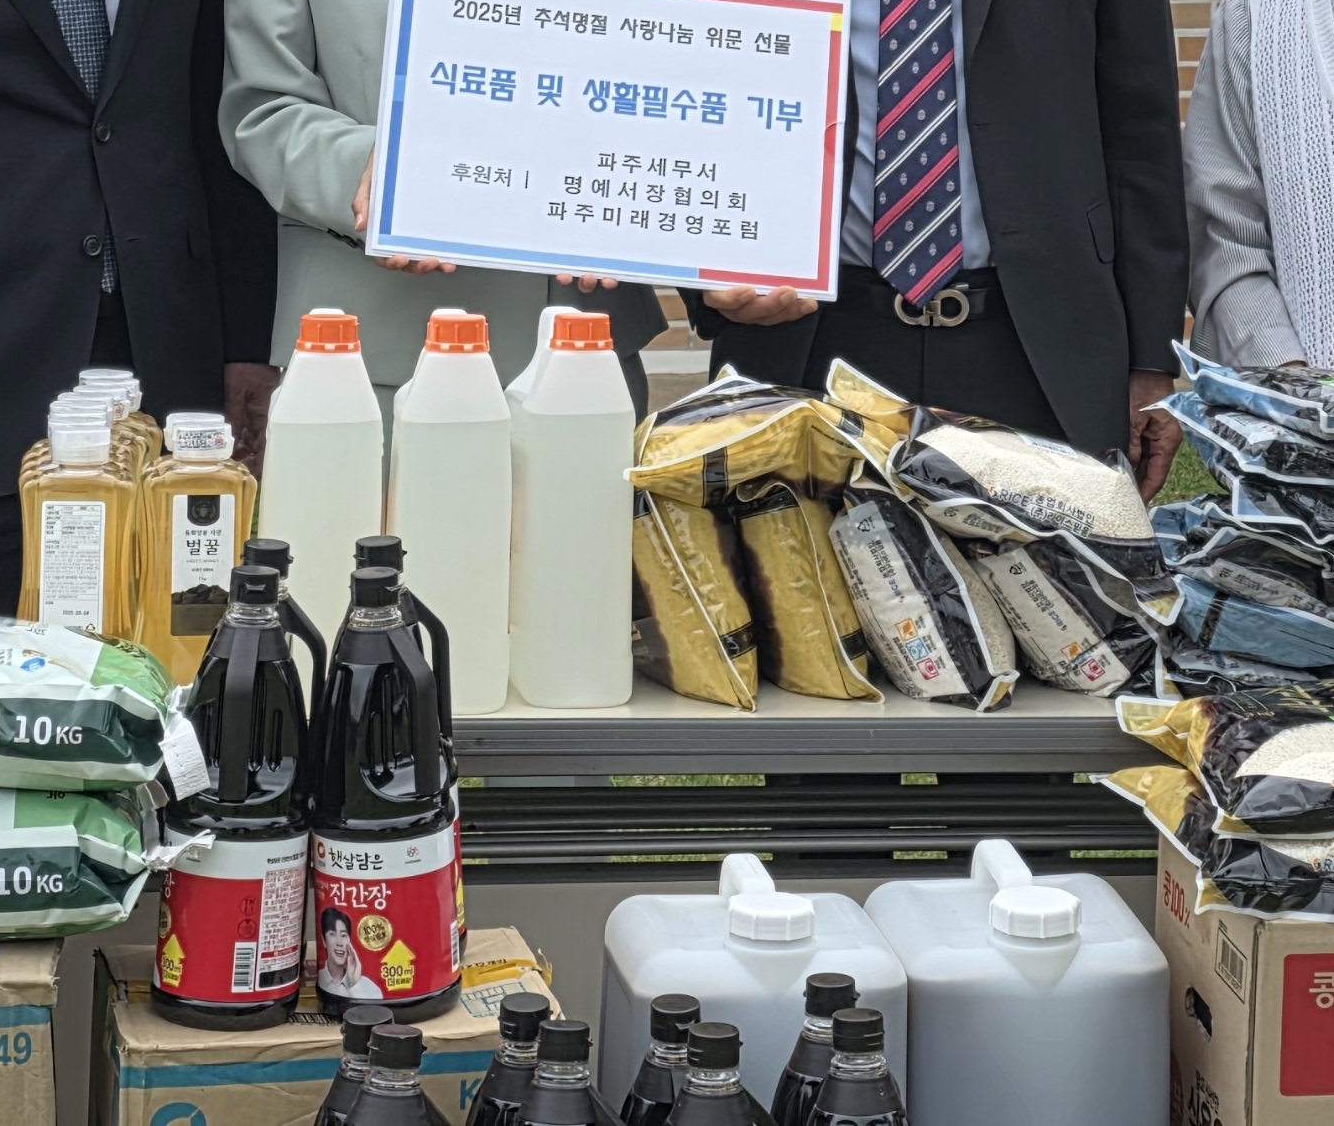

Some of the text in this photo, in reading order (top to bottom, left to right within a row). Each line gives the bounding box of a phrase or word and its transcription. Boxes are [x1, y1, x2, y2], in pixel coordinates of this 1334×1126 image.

[452, 0, 792, 56] 2025년 추석명절 사랑나눔 위문 선물
[429, 61, 803, 133] 식료품 및 생활필수품 기부
[450, 162, 513, 188] 후원처
[597, 152, 718, 182] 파주세무서
[563, 175, 749, 212] 명예서장협의회
[547, 201, 760, 240] 파주미래경영포럼
[999, 488, 1029, 507] RICE
[1035, 492, 1095, 524] 농업회사법인
[186, 539, 220, 556] 벌꿀
[328, 847, 384, 870] 햇살담은
[330, 881, 392, 910] 진간장
